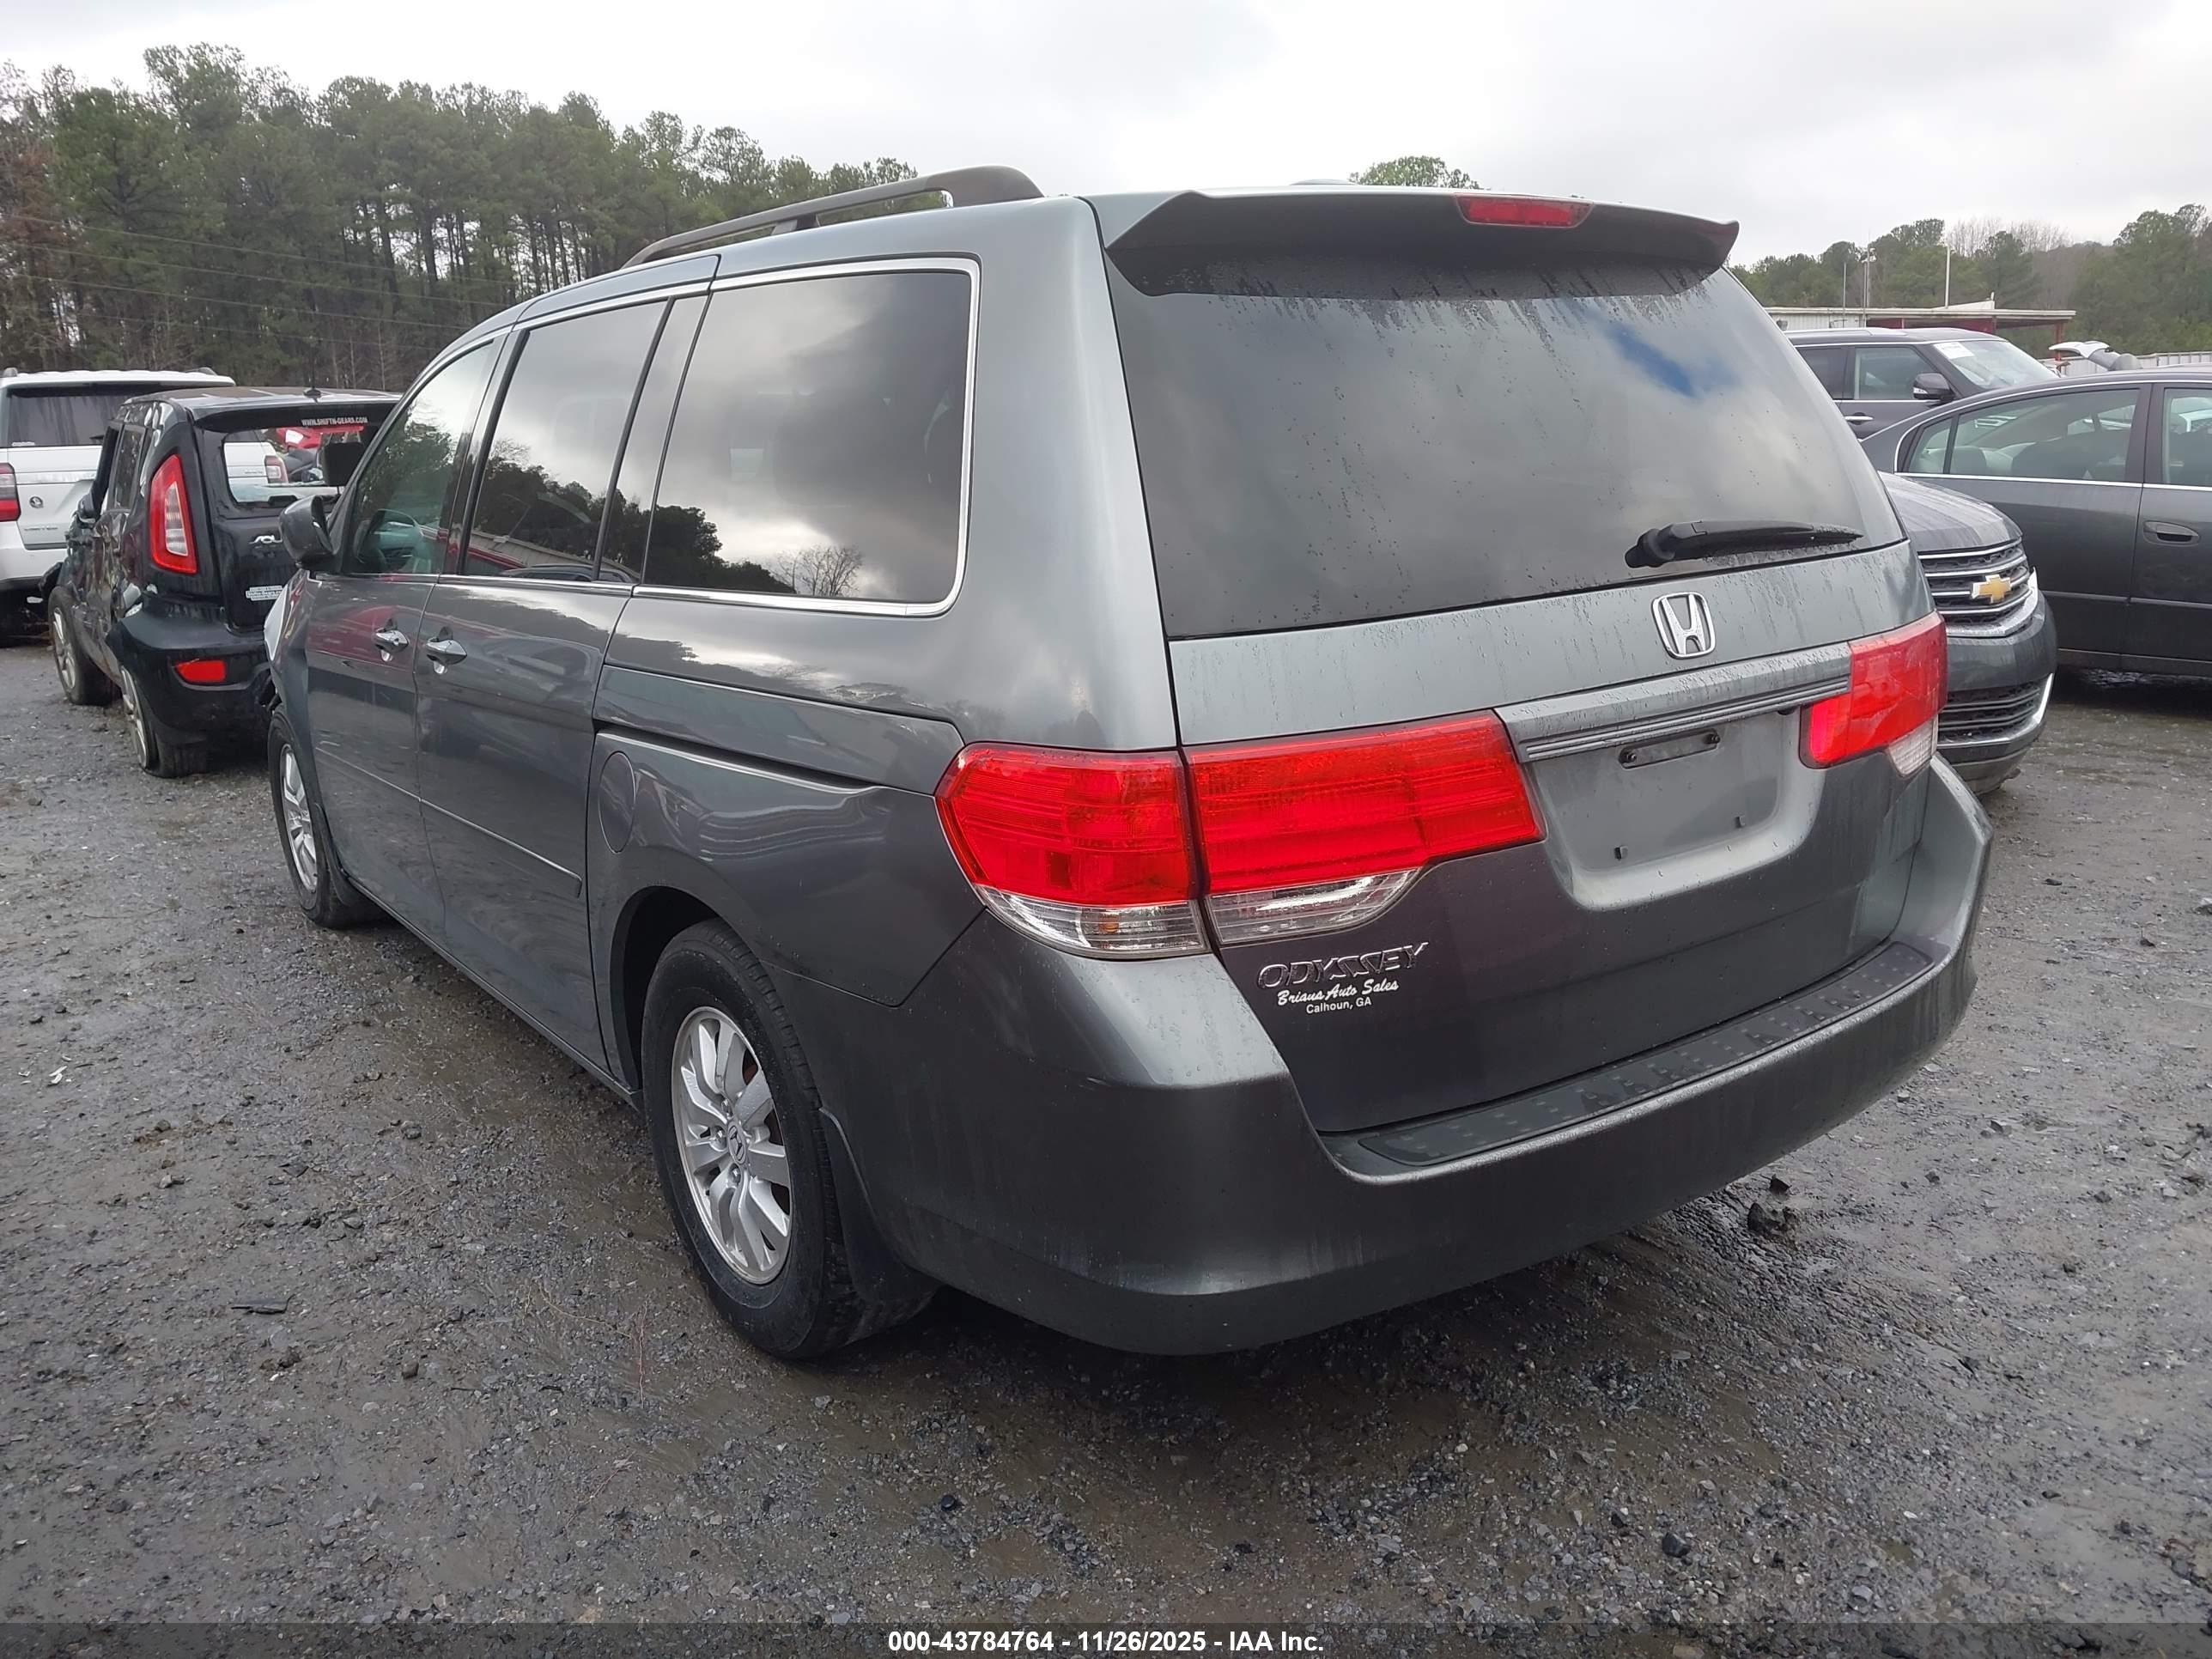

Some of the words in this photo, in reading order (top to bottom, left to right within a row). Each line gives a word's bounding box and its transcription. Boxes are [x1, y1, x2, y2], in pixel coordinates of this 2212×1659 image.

[1257, 941, 1429, 988] ODYSSEY
[1324, 983, 1358, 1000] Auto
[1362, 977, 1399, 995] Sales
[1306, 1000, 1353, 1013] Calhoun,
[1356, 996, 1372, 1007] GA
